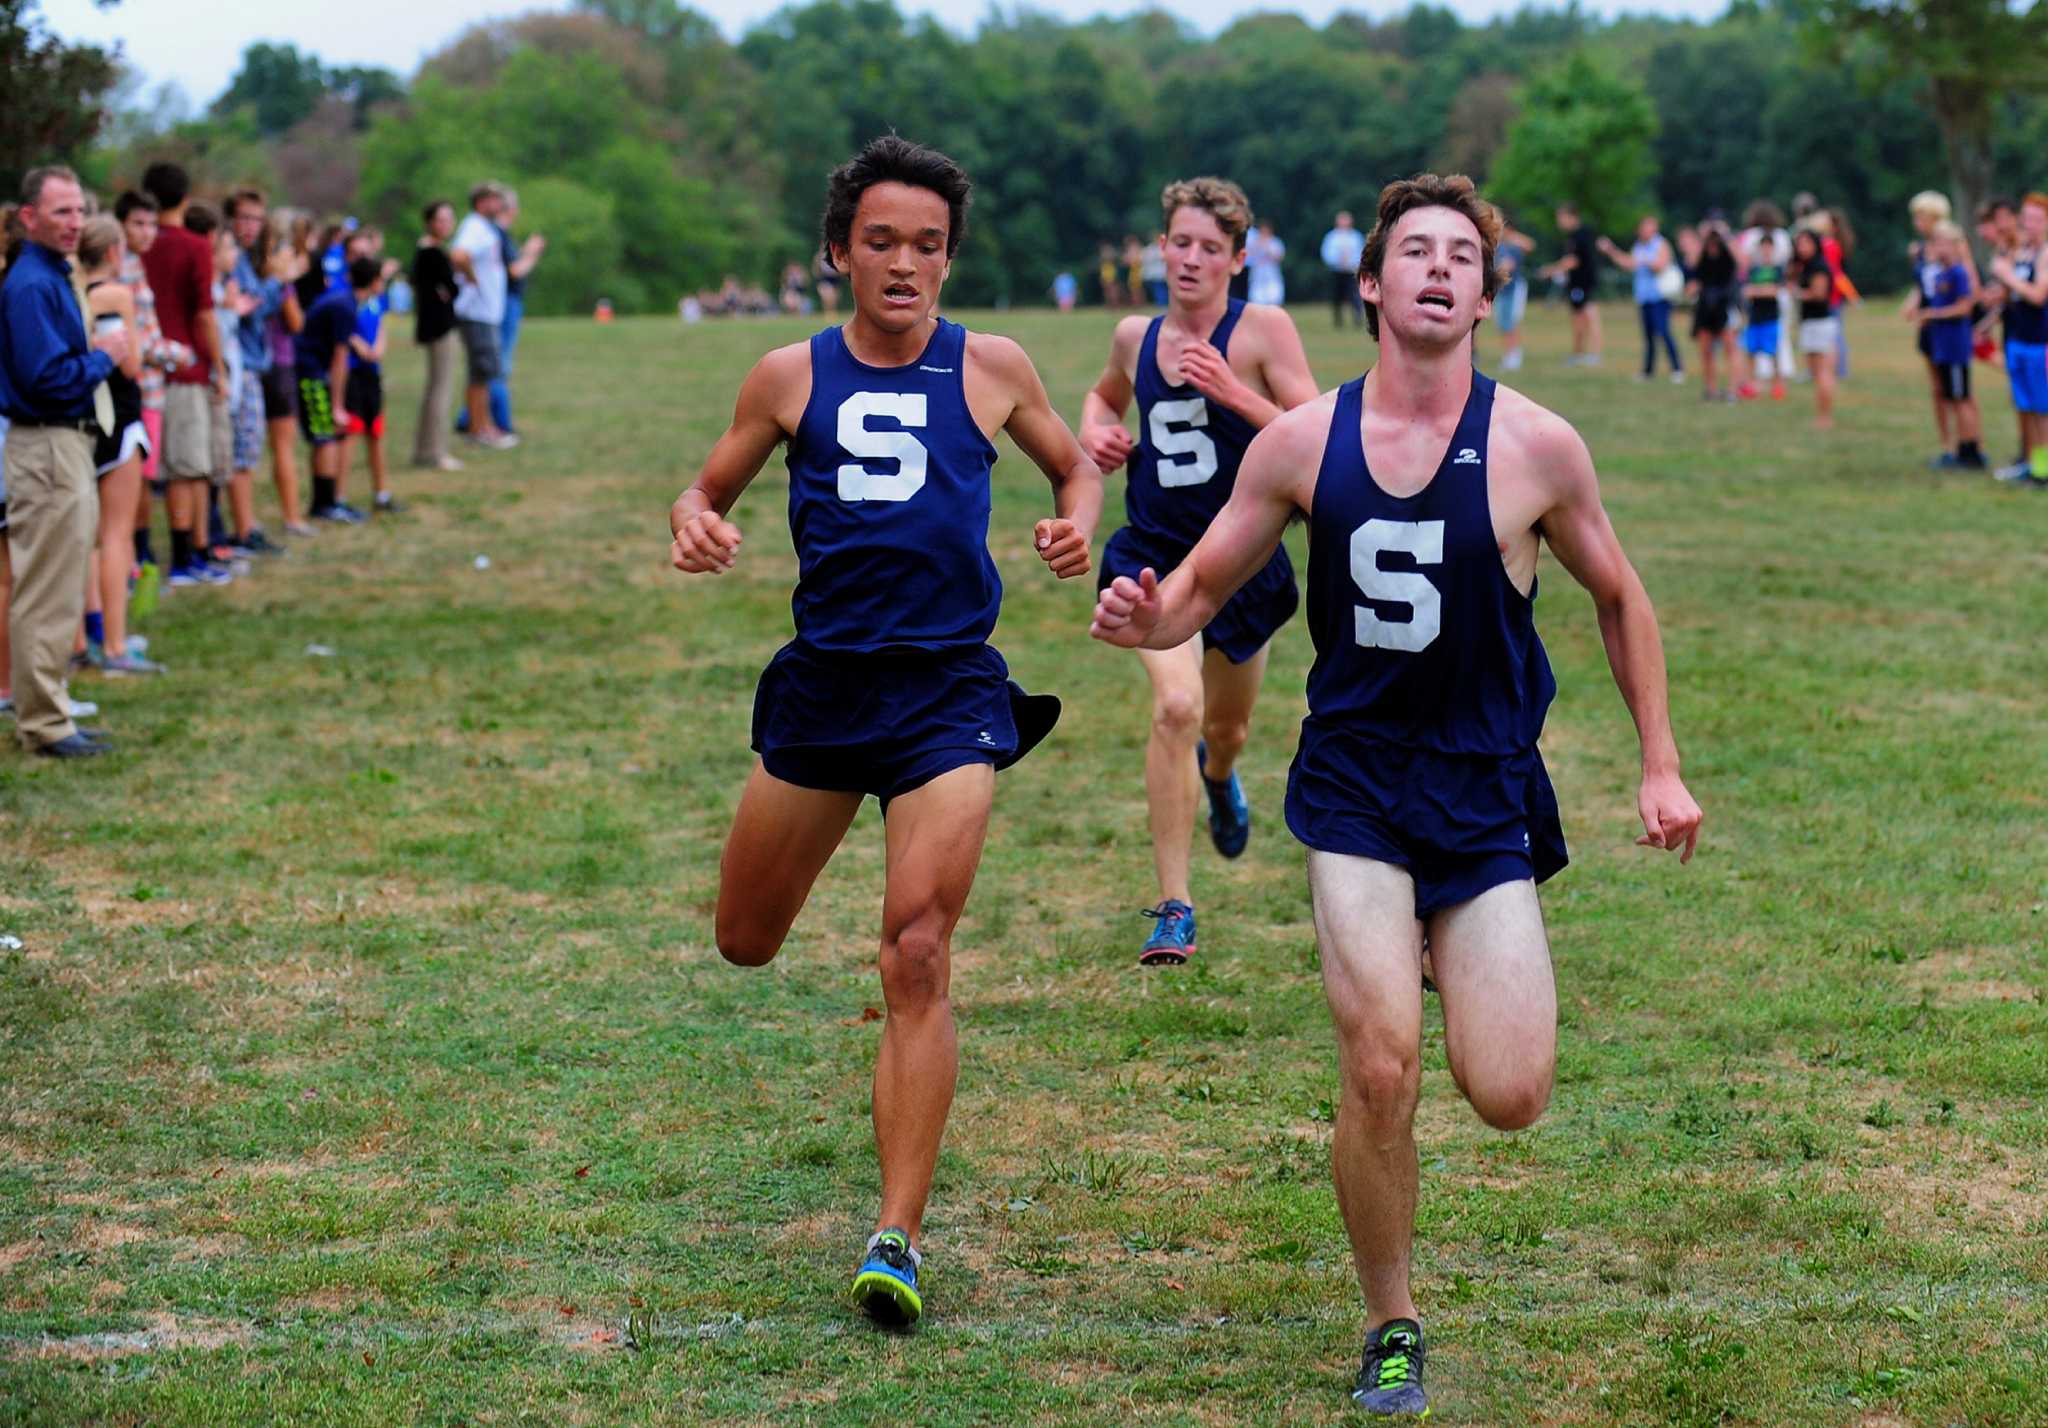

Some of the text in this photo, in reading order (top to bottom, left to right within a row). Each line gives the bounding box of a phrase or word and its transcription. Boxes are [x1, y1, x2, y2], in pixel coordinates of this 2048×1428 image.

[837, 392, 928, 502] S
[1149, 398, 1218, 488] S
[1350, 519, 1445, 652] S
